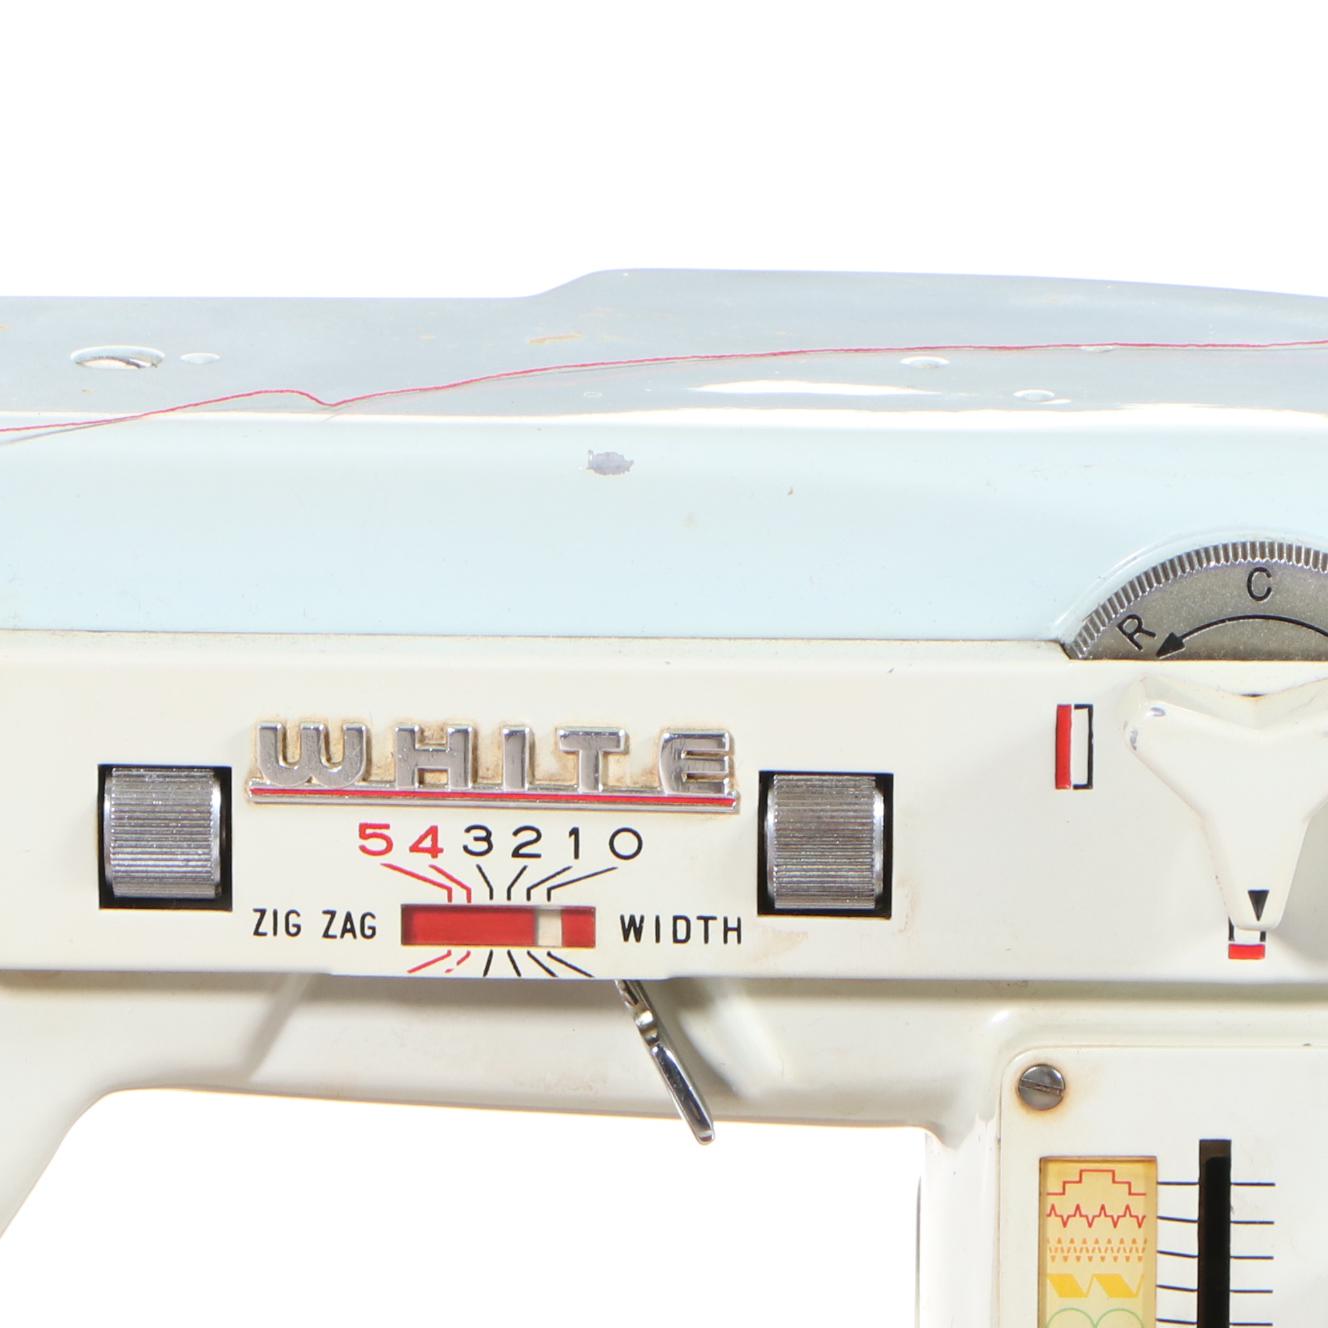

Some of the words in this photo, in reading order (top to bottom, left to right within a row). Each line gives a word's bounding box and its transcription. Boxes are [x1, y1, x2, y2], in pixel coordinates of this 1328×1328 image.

[1116, 613, 1157, 652] R
[1246, 566, 1273, 602] C
[258, 723, 731, 796] WHITE
[357, 822, 394, 857] 5
[408, 824, 445, 859] 4
[462, 824, 494, 858] 3
[511, 825, 543, 860] 2
[568, 826, 580, 860] 1
[608, 826, 644, 860] 0
[252, 907, 302, 938] ZIG
[321, 909, 378, 940] ZAG
[619, 912, 743, 946] WIDTH
